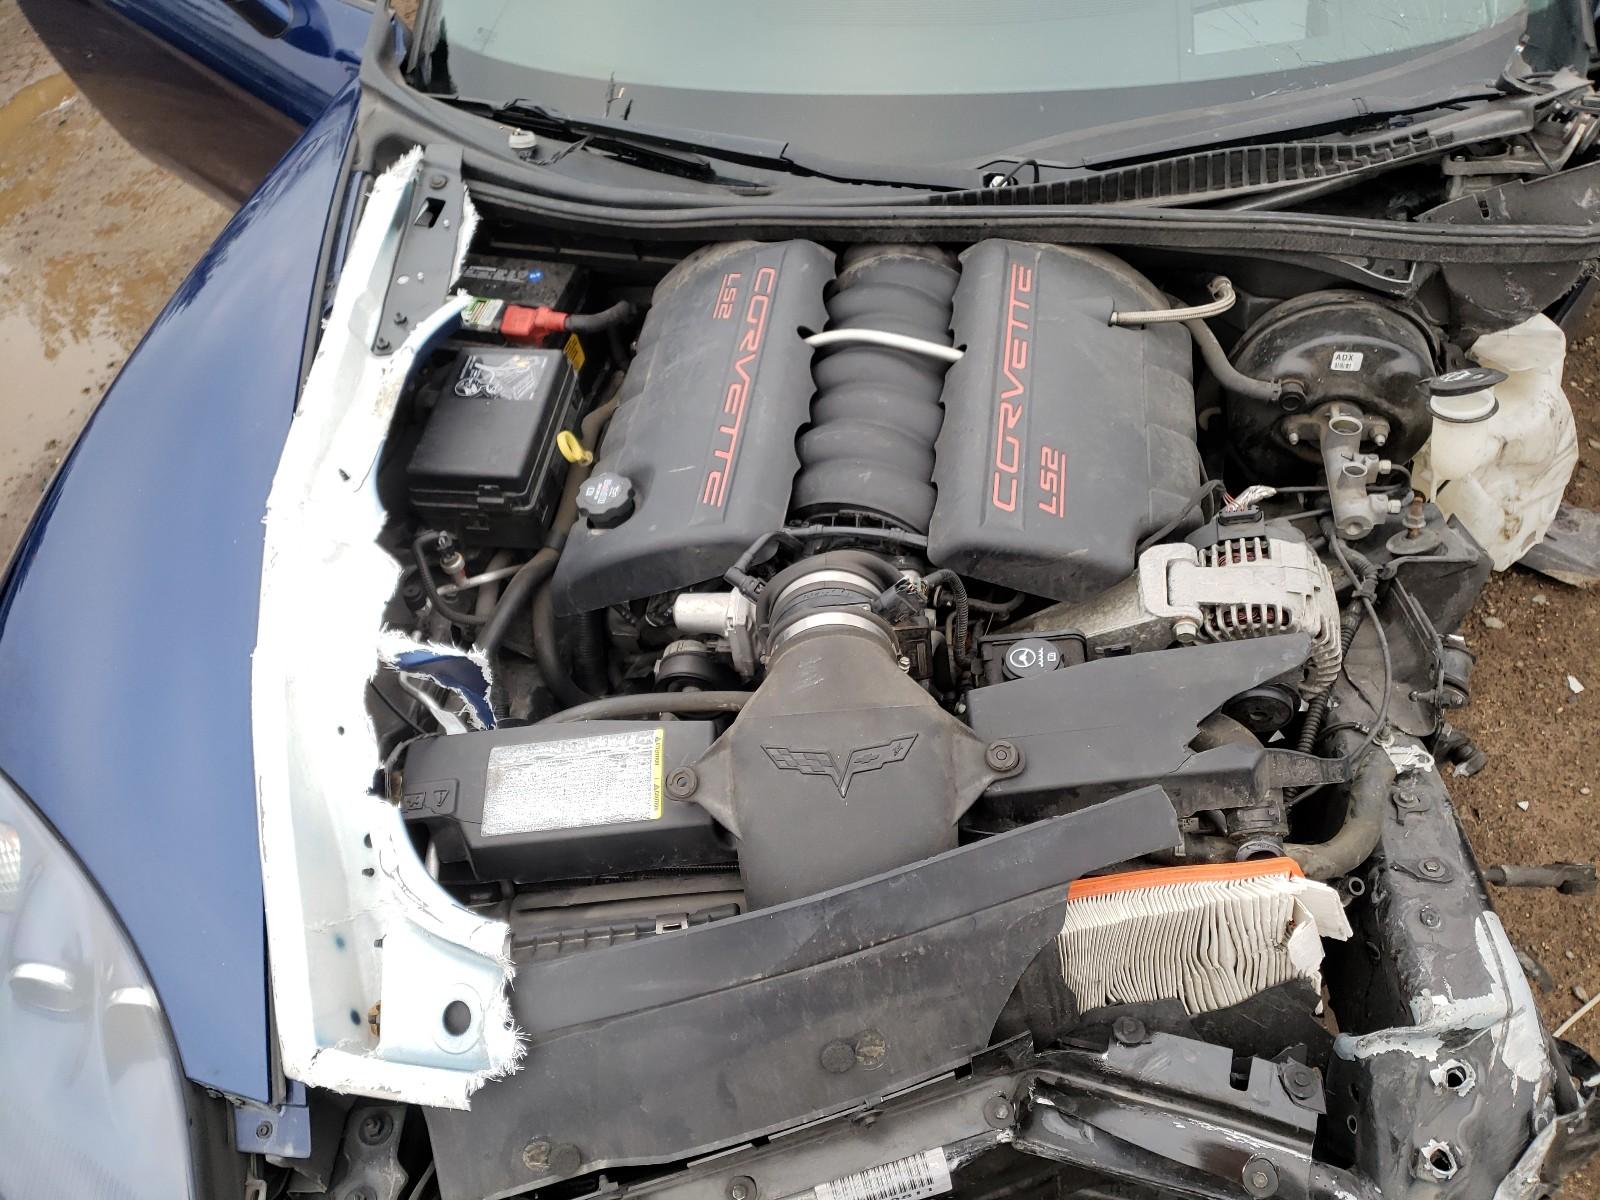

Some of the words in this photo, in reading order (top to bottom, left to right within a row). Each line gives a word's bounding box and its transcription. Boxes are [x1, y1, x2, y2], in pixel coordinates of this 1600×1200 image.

[717, 272, 742, 320] LS2
[703, 266, 776, 508] CORVETTE
[992, 263, 1034, 513] CORVETTE
[1336, 353, 1354, 361] ADX
[1039, 446, 1060, 515] LS2
